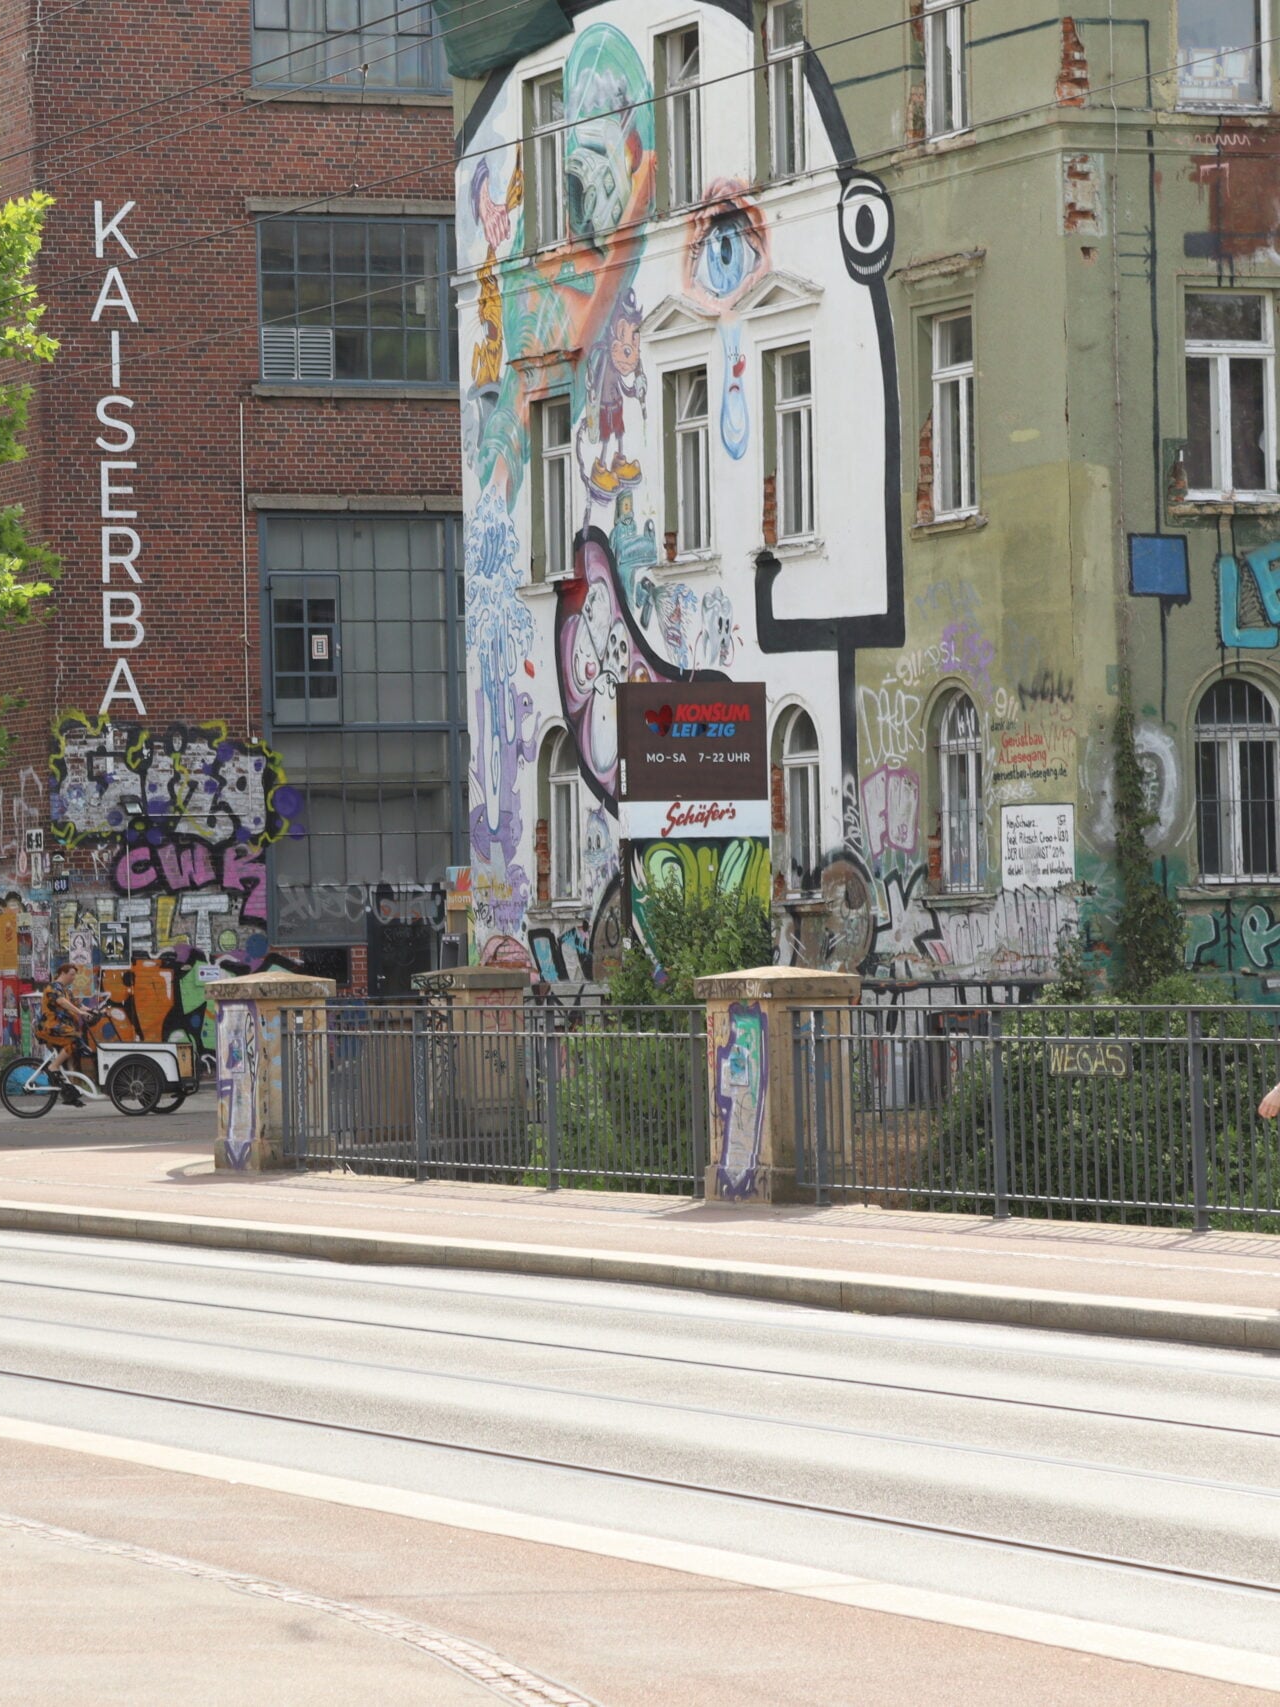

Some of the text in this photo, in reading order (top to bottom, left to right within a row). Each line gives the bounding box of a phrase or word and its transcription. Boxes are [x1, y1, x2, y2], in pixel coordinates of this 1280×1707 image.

[674, 702, 752, 722] KONSUM
[727, 752, 751, 763] UHR
[661, 801, 736, 838] Schäfer's
